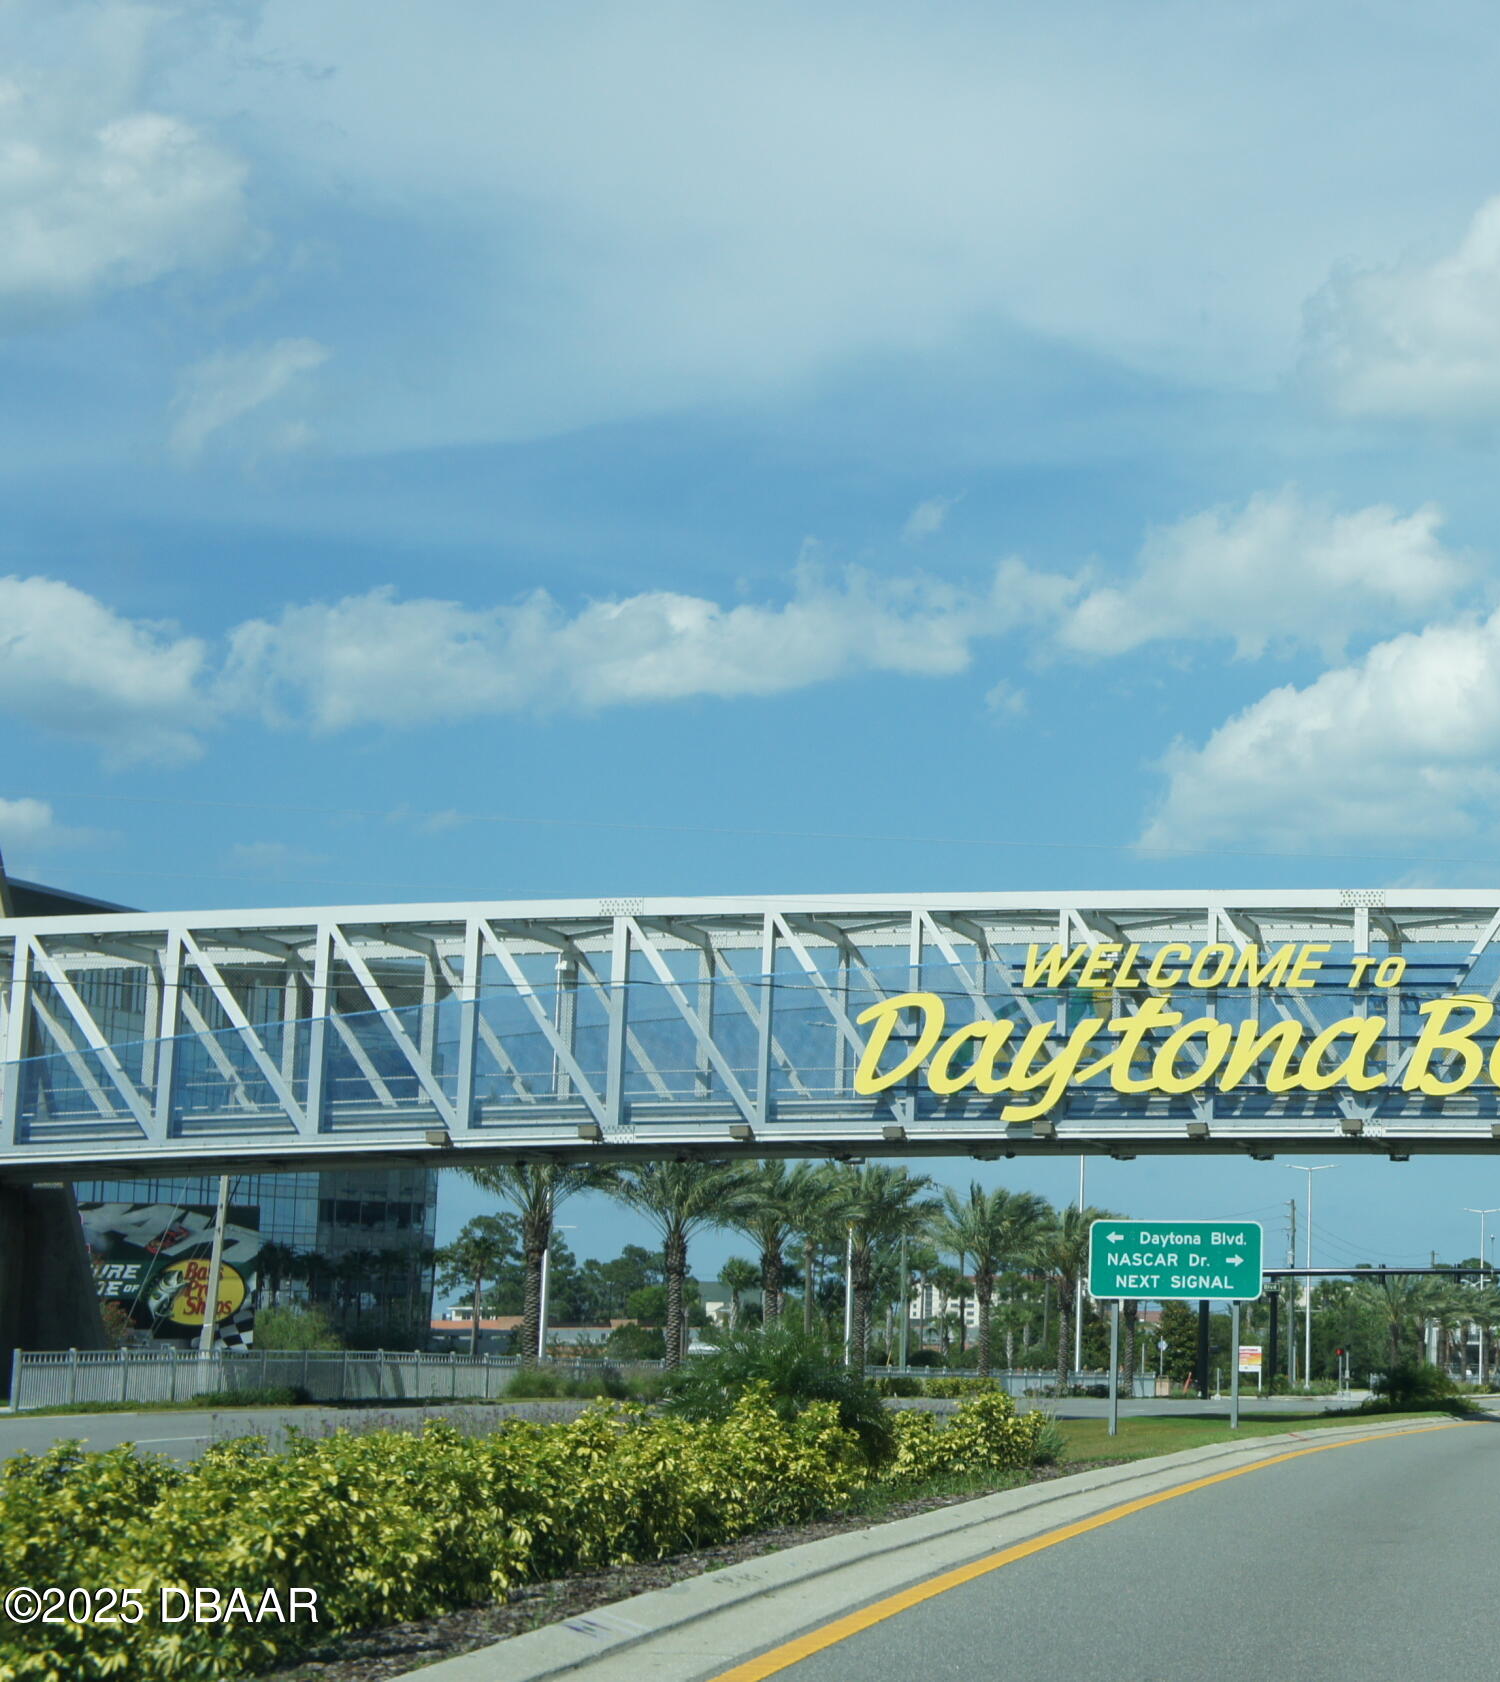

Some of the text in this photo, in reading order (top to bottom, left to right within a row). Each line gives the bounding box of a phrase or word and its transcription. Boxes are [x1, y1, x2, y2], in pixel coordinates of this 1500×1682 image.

[1022, 943, 1406, 988] WELCOME TO
[853, 992, 1388, 1121] Daytona
[1139, 1231, 1247, 1247] Daytona Blvd.
[1107, 1253, 1210, 1267] NASCAR Dr.
[1116, 1275, 1234, 1289] NEXT SIGNAL
[183, 1296, 233, 1315] Shps
